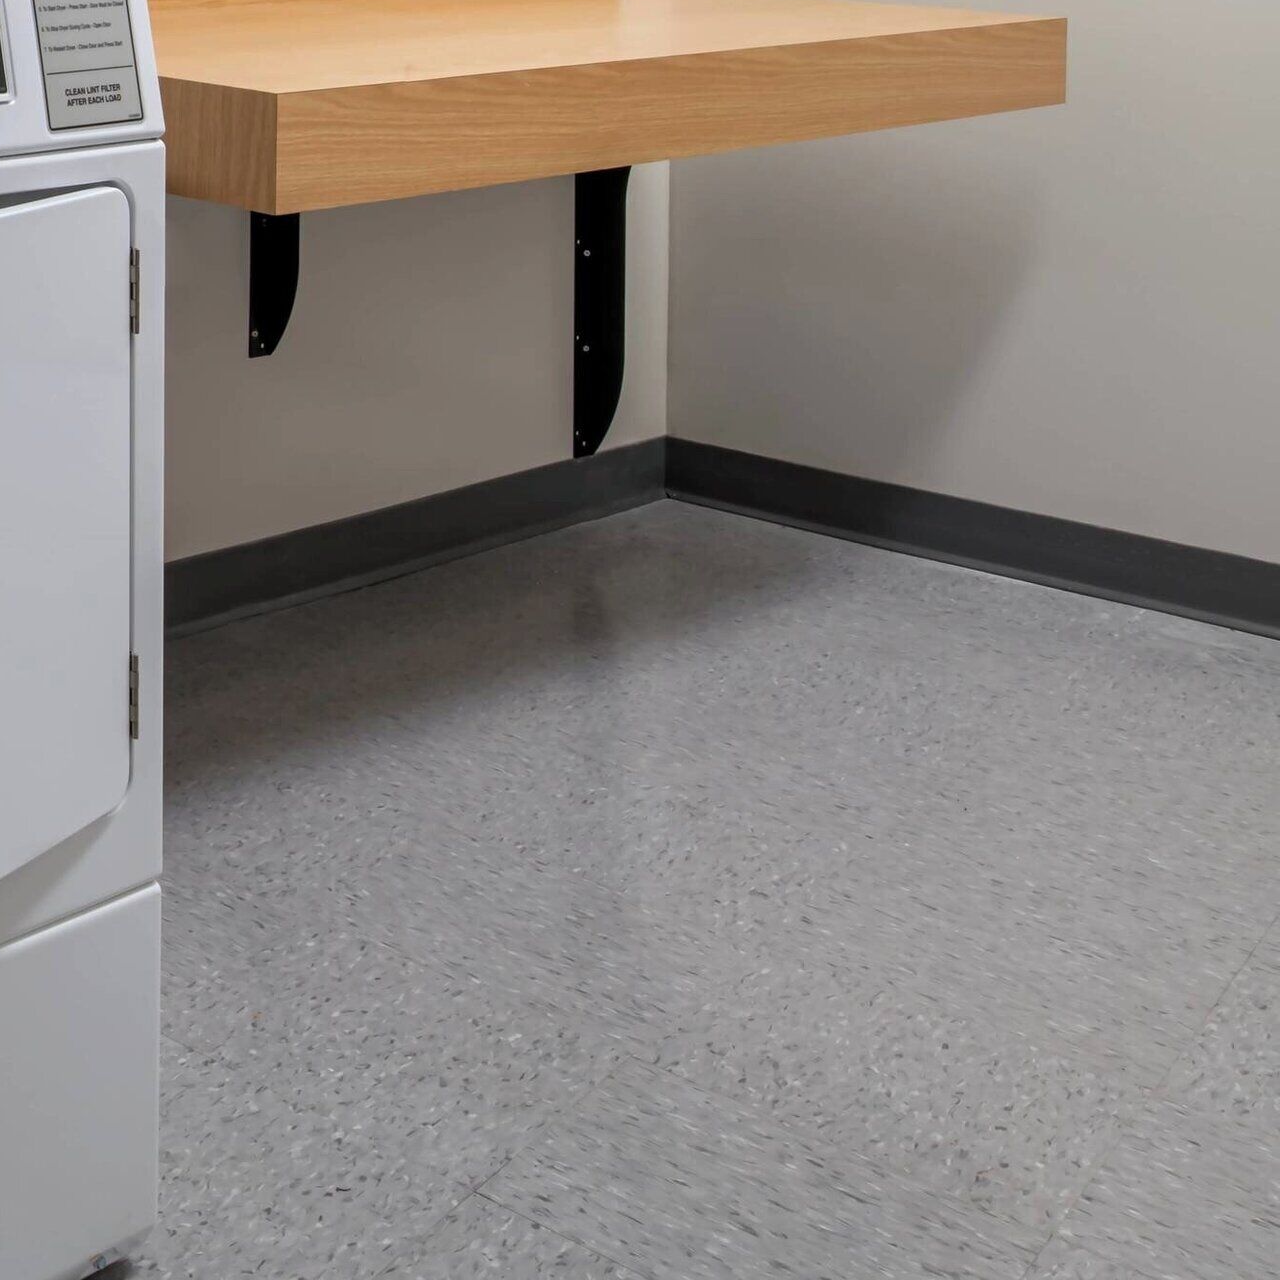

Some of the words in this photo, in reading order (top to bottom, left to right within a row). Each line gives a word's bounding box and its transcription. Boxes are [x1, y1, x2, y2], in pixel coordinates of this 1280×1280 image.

[65, 87, 86, 96] CLEAN
[86, 85, 100, 95] LINT
[101, 84, 121, 92] FILTER
[67, 97, 87, 106] AFTER
[88, 95, 104, 105] EACH
[105, 93, 121, 102] LOAD
